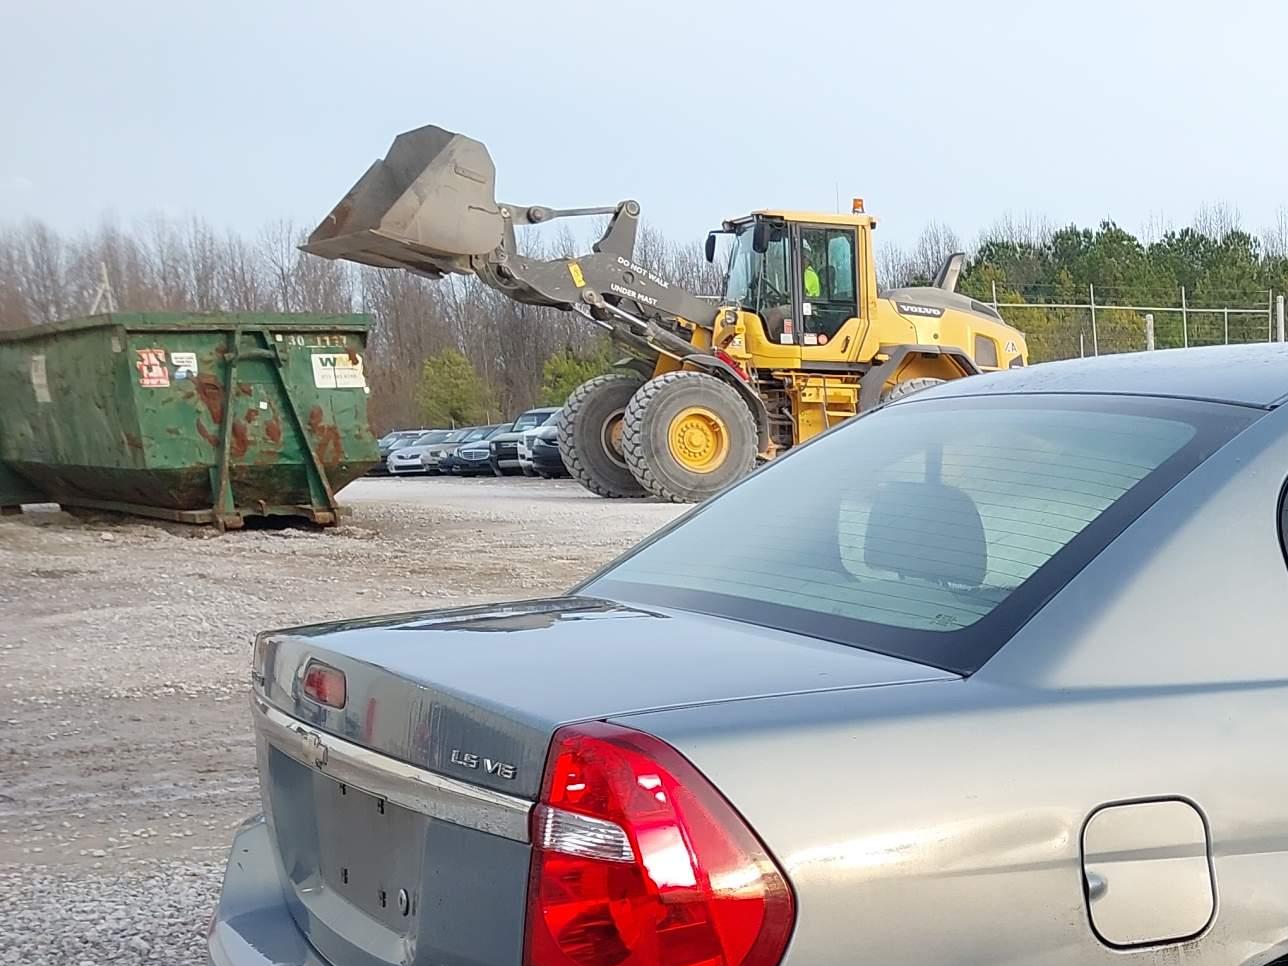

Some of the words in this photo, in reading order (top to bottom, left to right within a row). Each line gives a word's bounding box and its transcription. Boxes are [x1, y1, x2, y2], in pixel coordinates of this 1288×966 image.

[617, 256, 630, 267] DO
[630, 263, 647, 276] NOT
[648, 272, 669, 288] WALK
[611, 283, 636, 297] UNDER
[637, 293, 658, 305] MAST
[900, 304, 941, 315] VOLVO
[451, 748, 480, 769] LS
[483, 757, 517, 779] V6
